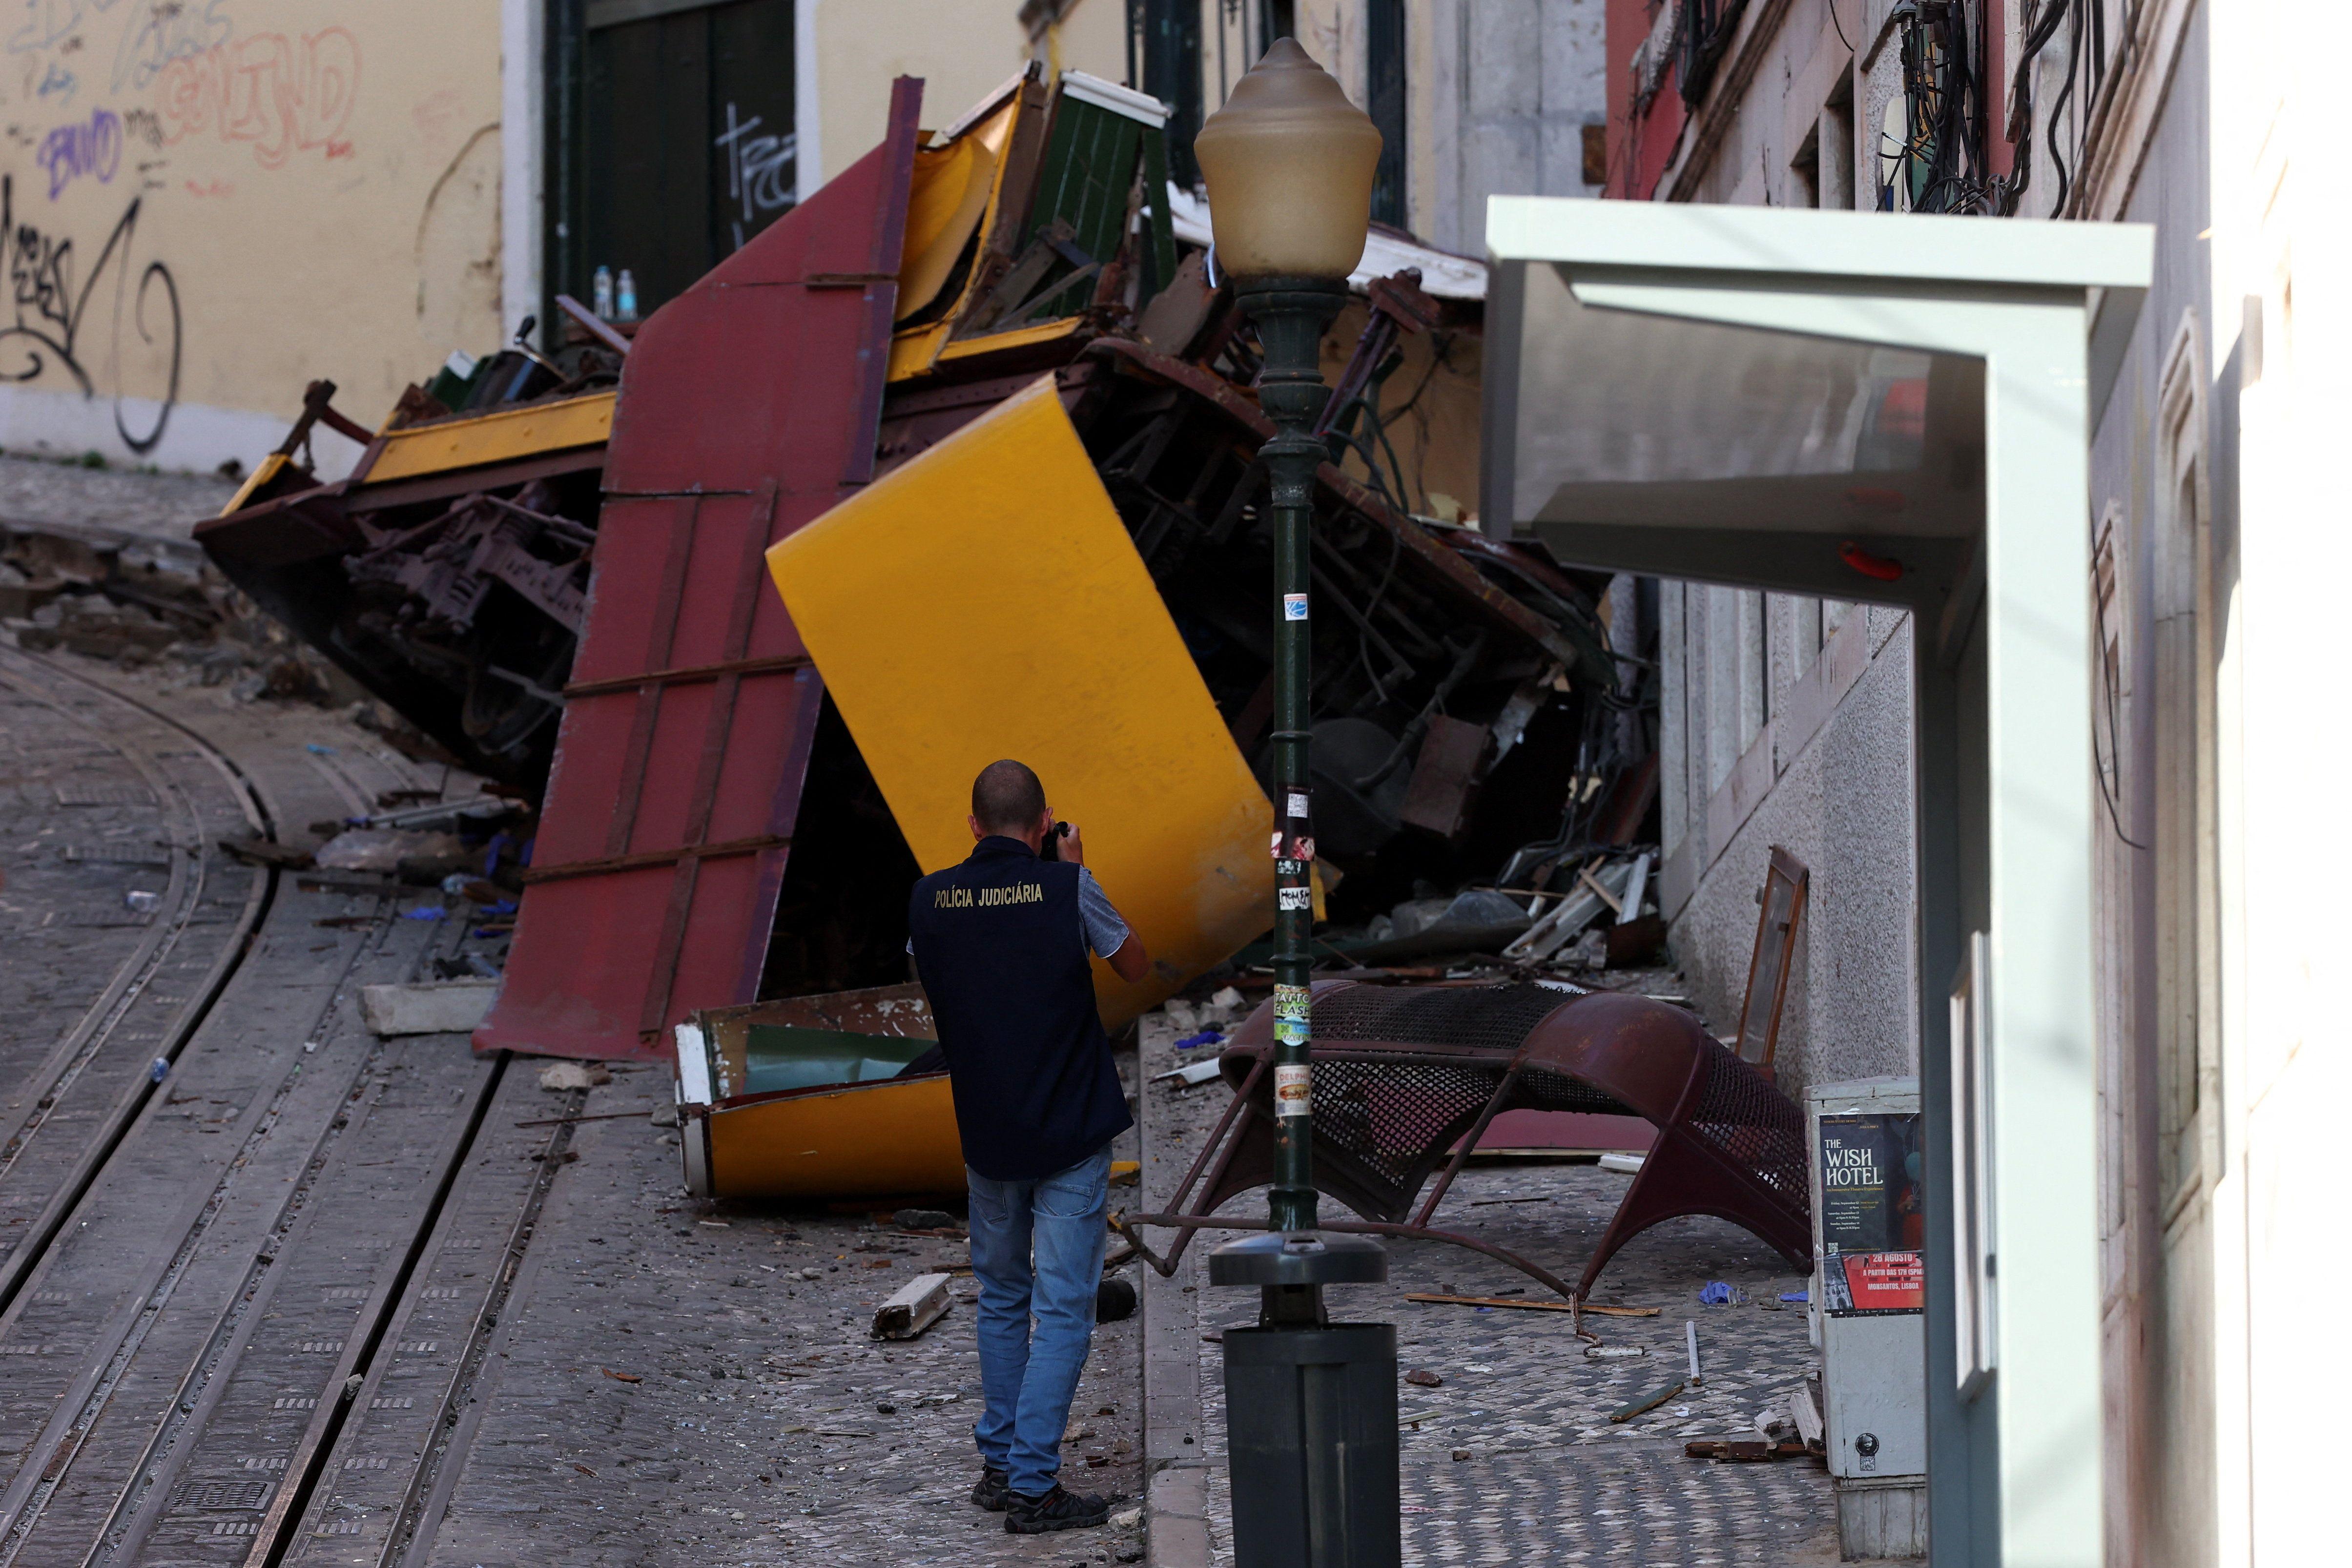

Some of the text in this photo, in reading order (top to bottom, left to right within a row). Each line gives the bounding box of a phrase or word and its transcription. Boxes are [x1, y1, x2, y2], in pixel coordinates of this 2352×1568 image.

[934, 881, 1043, 908] POLÍCIA JUDICIÁRIA
[1276, 1005, 1310, 1014] FLASH
[1824, 1139, 1841, 1148] THE
[1825, 1149, 1872, 1167] WISH
[1826, 1167, 1883, 1186] HOTEL
[1873, 1253, 1913, 1262] 28 AGOSTO
